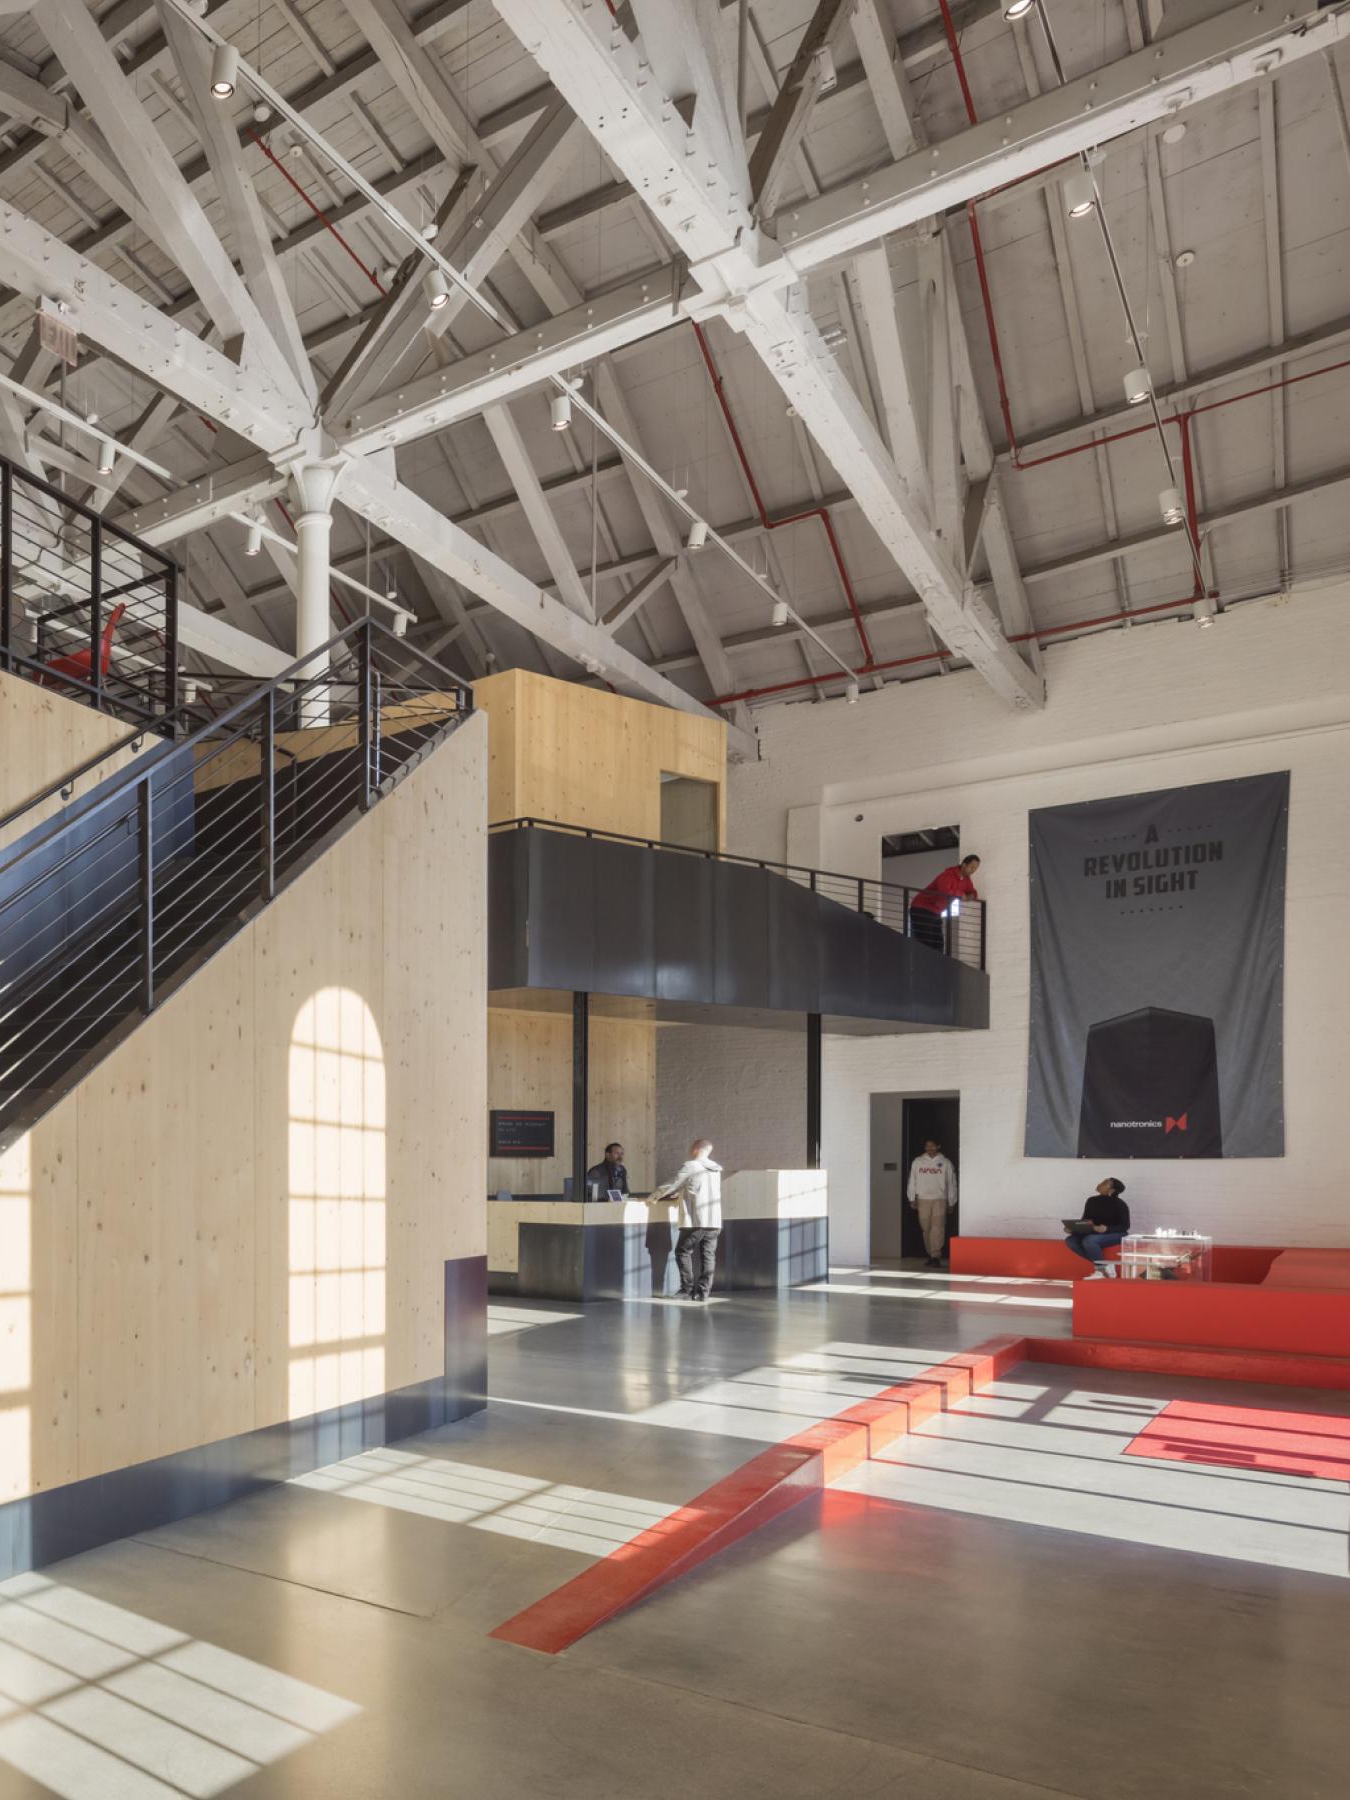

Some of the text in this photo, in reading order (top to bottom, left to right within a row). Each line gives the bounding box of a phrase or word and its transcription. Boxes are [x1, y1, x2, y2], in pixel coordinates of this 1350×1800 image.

[1145, 824, 1159, 844] A
[1084, 841, 1223, 876] REVOLUTION
[1106, 870, 1199, 899] IN SIGHT
[1110, 1120, 1162, 1128] nanotronics
